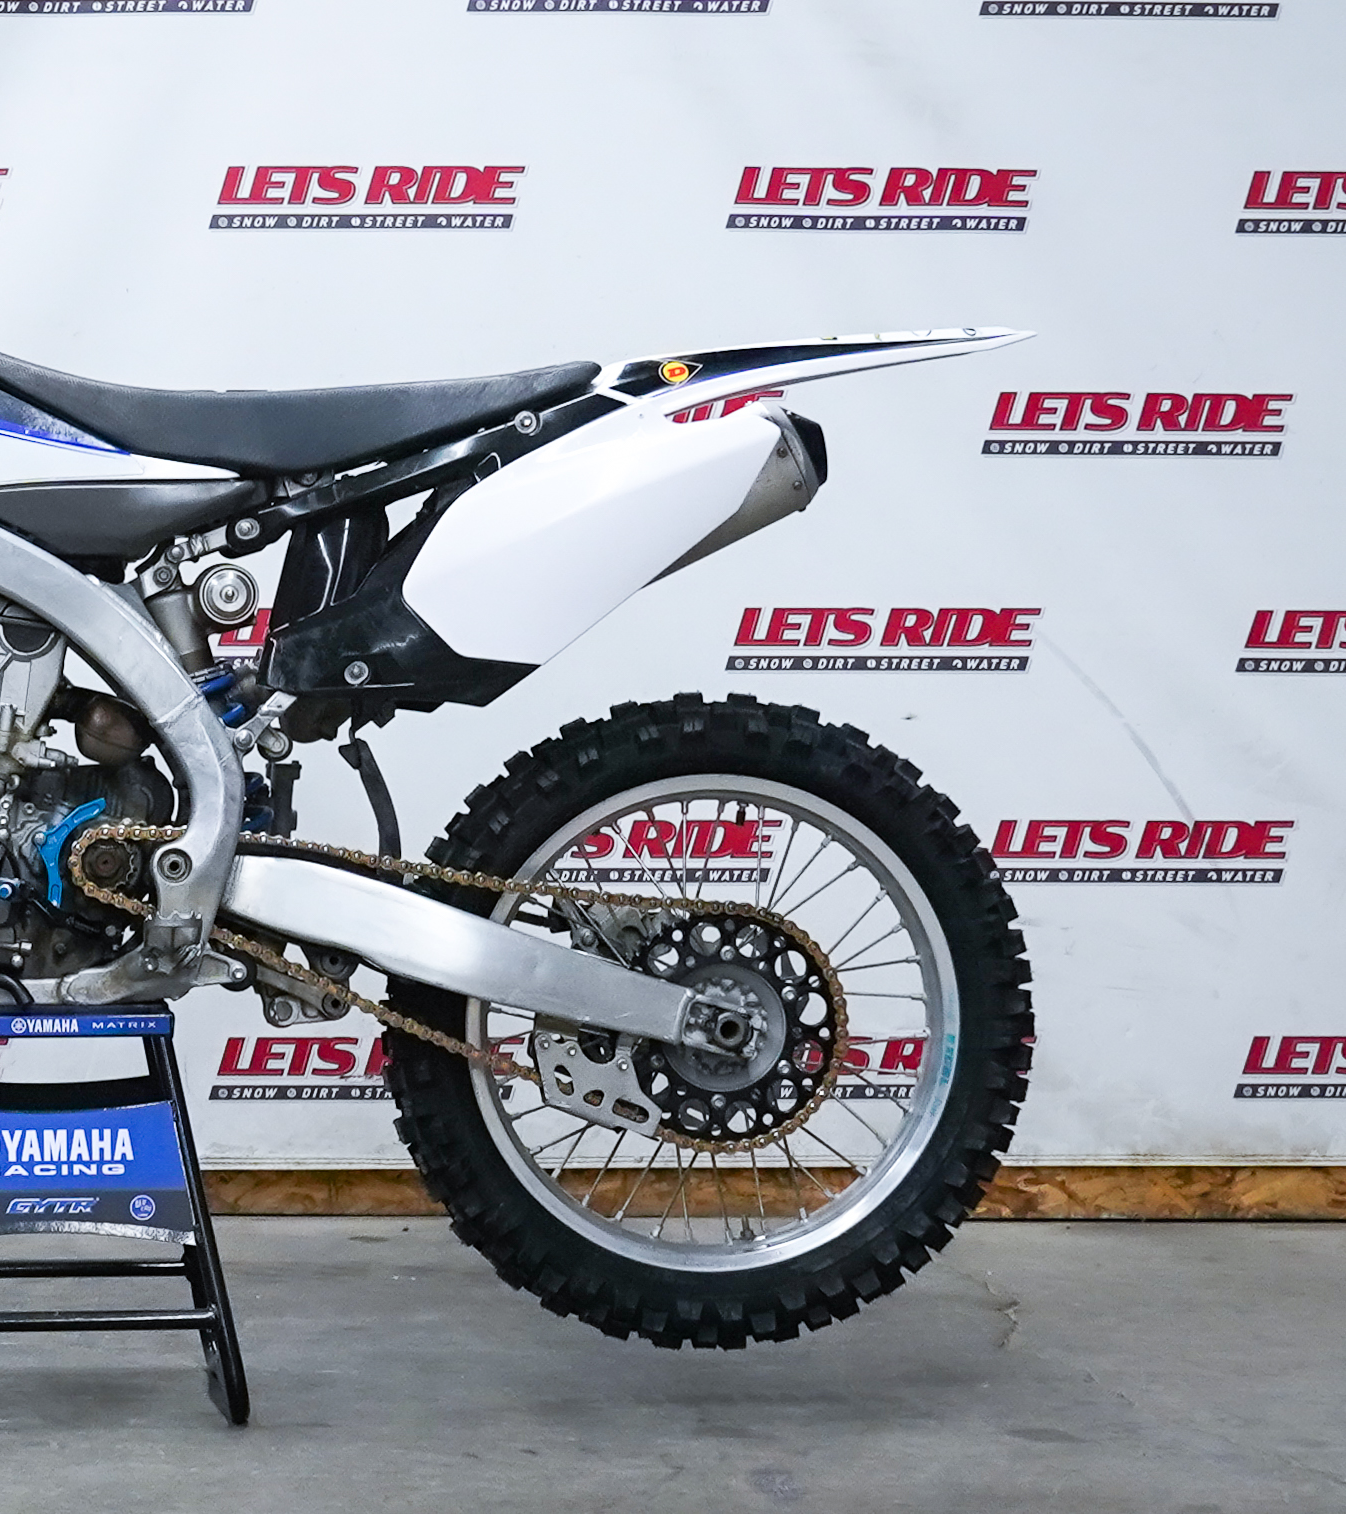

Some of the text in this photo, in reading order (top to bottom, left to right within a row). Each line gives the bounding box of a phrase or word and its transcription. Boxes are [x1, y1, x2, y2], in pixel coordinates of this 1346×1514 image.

[43, 2, 81, 12] DIRT
[105, 1, 166, 12] STREET
[192, 0, 245, 11] WATER
[489, 0, 761, 11] SNOW DIRT STREET WATER
[1002, 4, 1270, 16] SNOW DIRT STREET WATER
[218, 166, 526, 204] LETS RIDE
[734, 167, 1038, 207] LETS RIDE
[1243, 171, 1346, 209] LET
[232, 217, 504, 227] SNOW DIRT STREET WATER
[749, 217, 1018, 229] SNOW DIRT STREET WATER
[1258, 222, 1346, 232] SNOW DI
[989, 392, 1293, 432] LETS RIDE
[1003, 443, 1273, 455] SNOW DIRT STREET WATER
[734, 608, 1041, 646] LETS RIDE
[1244, 610, 1346, 649] LET
[748, 659, 1020, 670] SNOW DIRT STREET WATER
[1259, 661, 1346, 671] SNOW DI
[622, 820, 782, 858] RIDE
[992, 820, 1294, 859] LETS RIDE
[1003, 870, 1274, 882] SNOW DIRT STREET WATER
[26, 1019, 79, 1033] YAMAHA
[92, 1021, 157, 1029] MATRIX
[217, 1037, 358, 1076] LETS
[1242, 1036, 1346, 1074] LET
[232, 1088, 278, 1098] SNOW
[302, 1088, 339, 1098] DIRT
[1256, 1087, 1346, 1096] SNOW DI
[1, 1128, 134, 1163] YAMAHA
